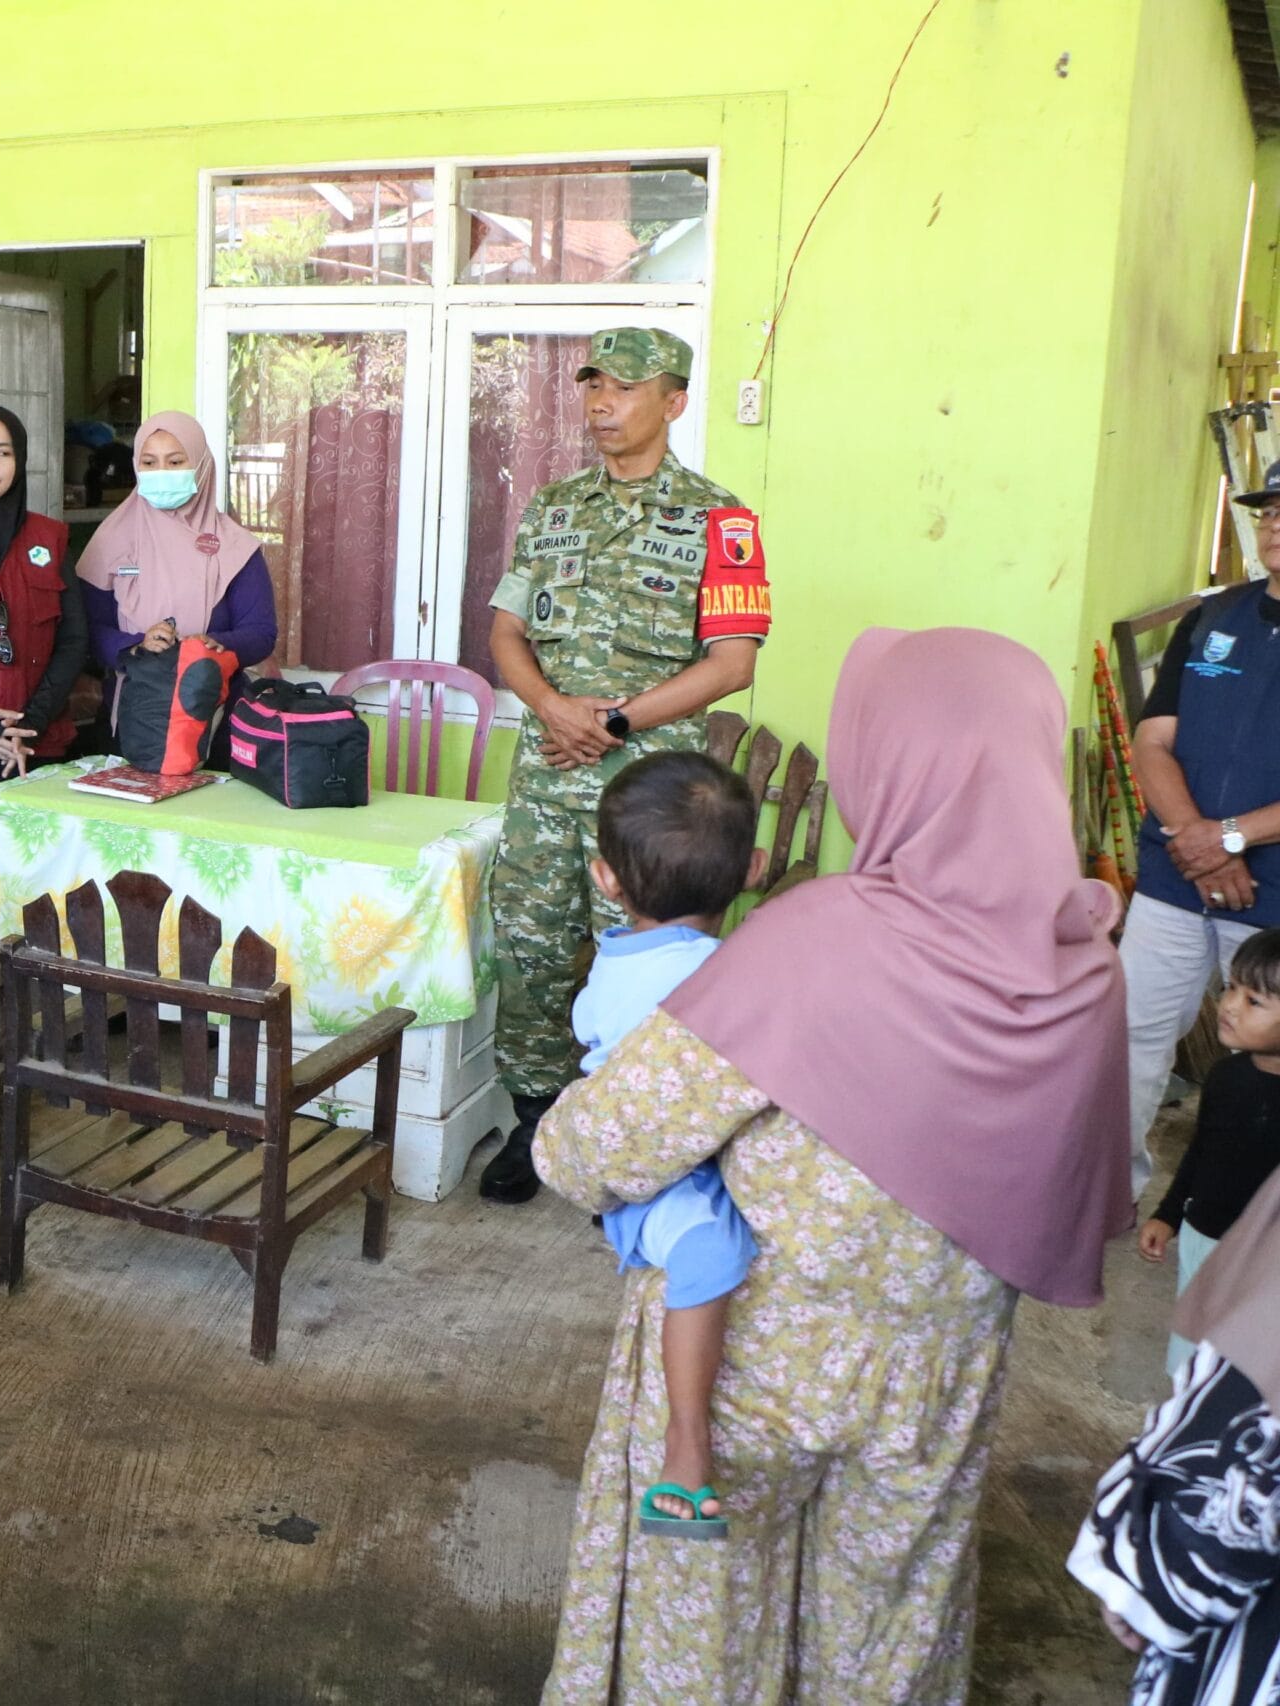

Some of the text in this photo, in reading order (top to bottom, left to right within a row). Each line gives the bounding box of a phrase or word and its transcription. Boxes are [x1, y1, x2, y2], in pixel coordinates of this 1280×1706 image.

[534, 534, 580, 552] MURIANTO
[642, 539, 698, 562] TNI AD
